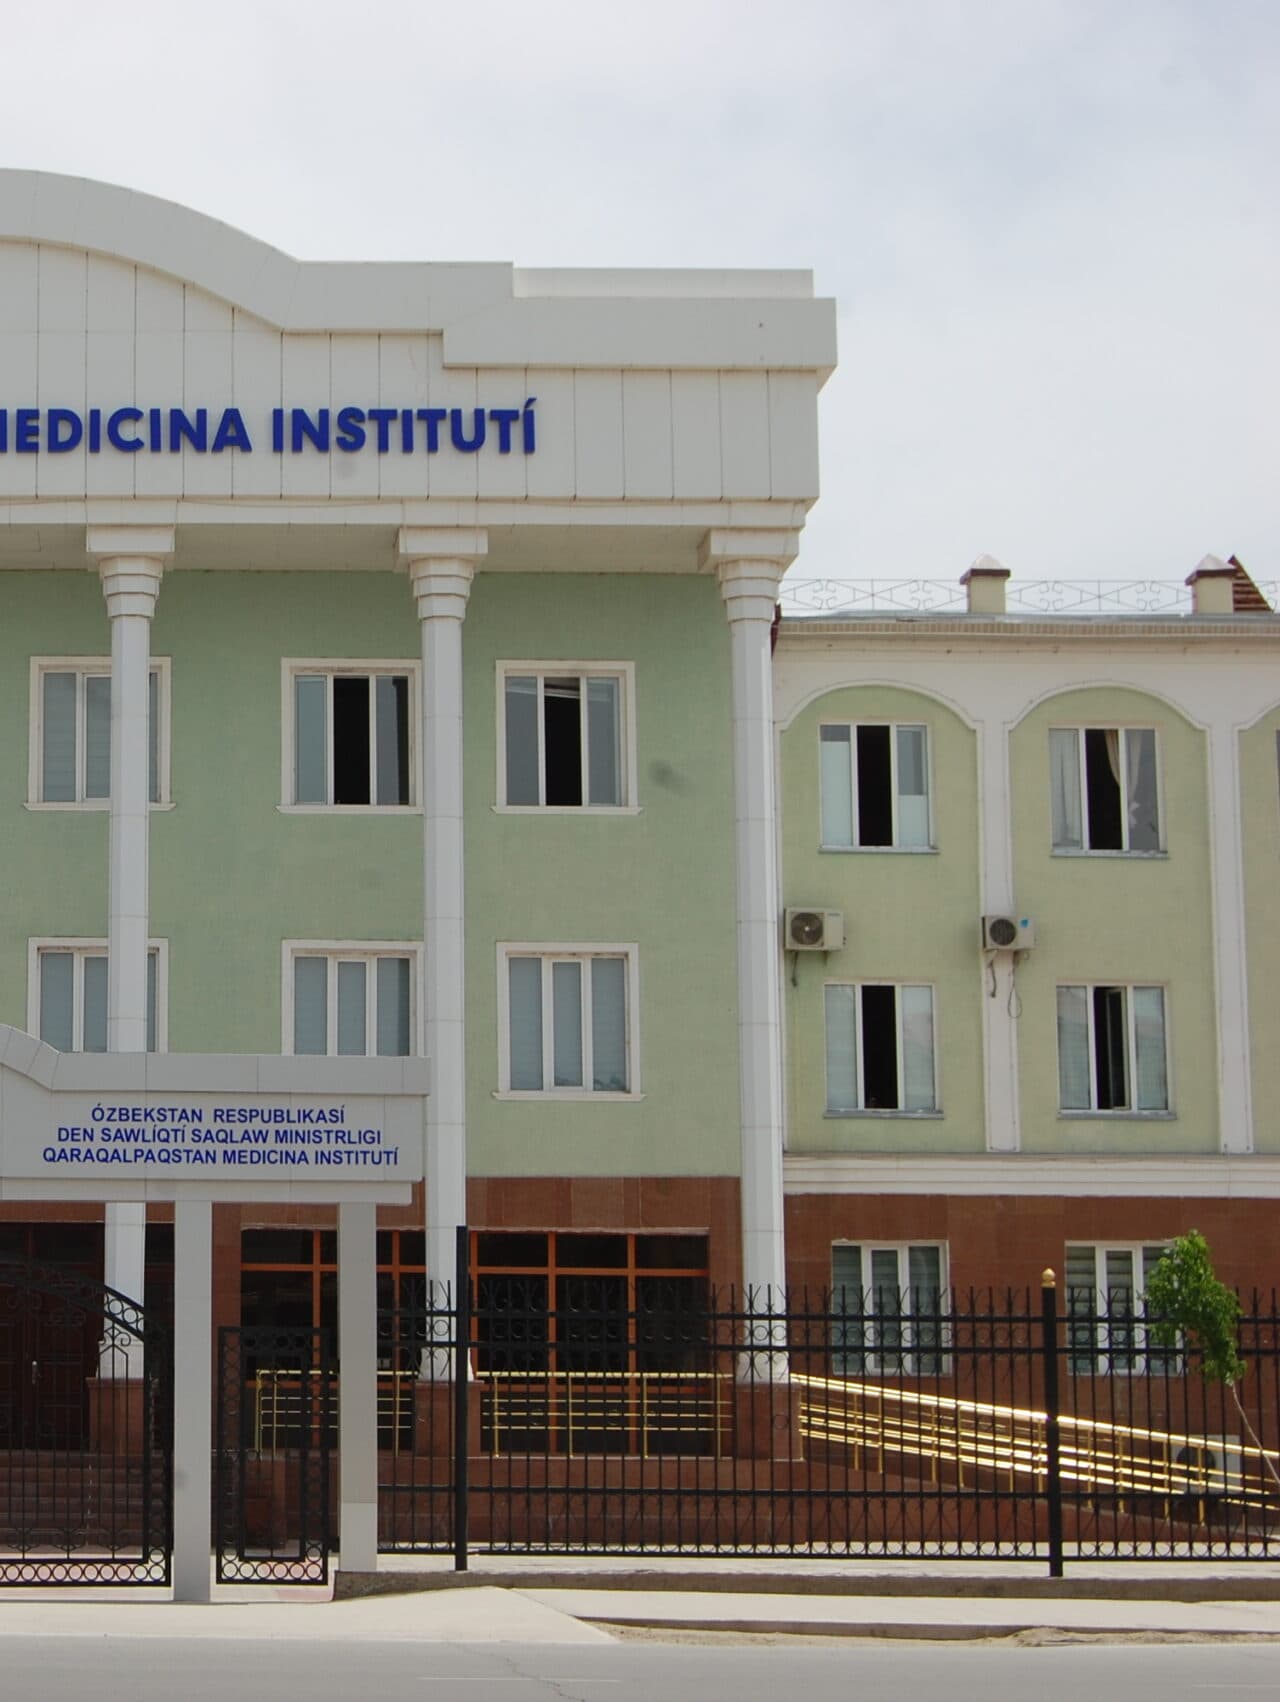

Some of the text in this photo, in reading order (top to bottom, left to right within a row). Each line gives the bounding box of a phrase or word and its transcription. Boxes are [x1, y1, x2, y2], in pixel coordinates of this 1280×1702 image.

[273, 397, 537, 453] INSTITUTÍ
[91, 1104, 345, 1123] ÓZBEKSTAN RESPUBLIKASÍ
[57, 1125, 383, 1145] DEN SAWLÍQTÍ SAQLAW MINISTRLIGI
[43, 1147, 399, 1166] QARAQALPAQSTAN MEDICINA INSTITUTÍ
